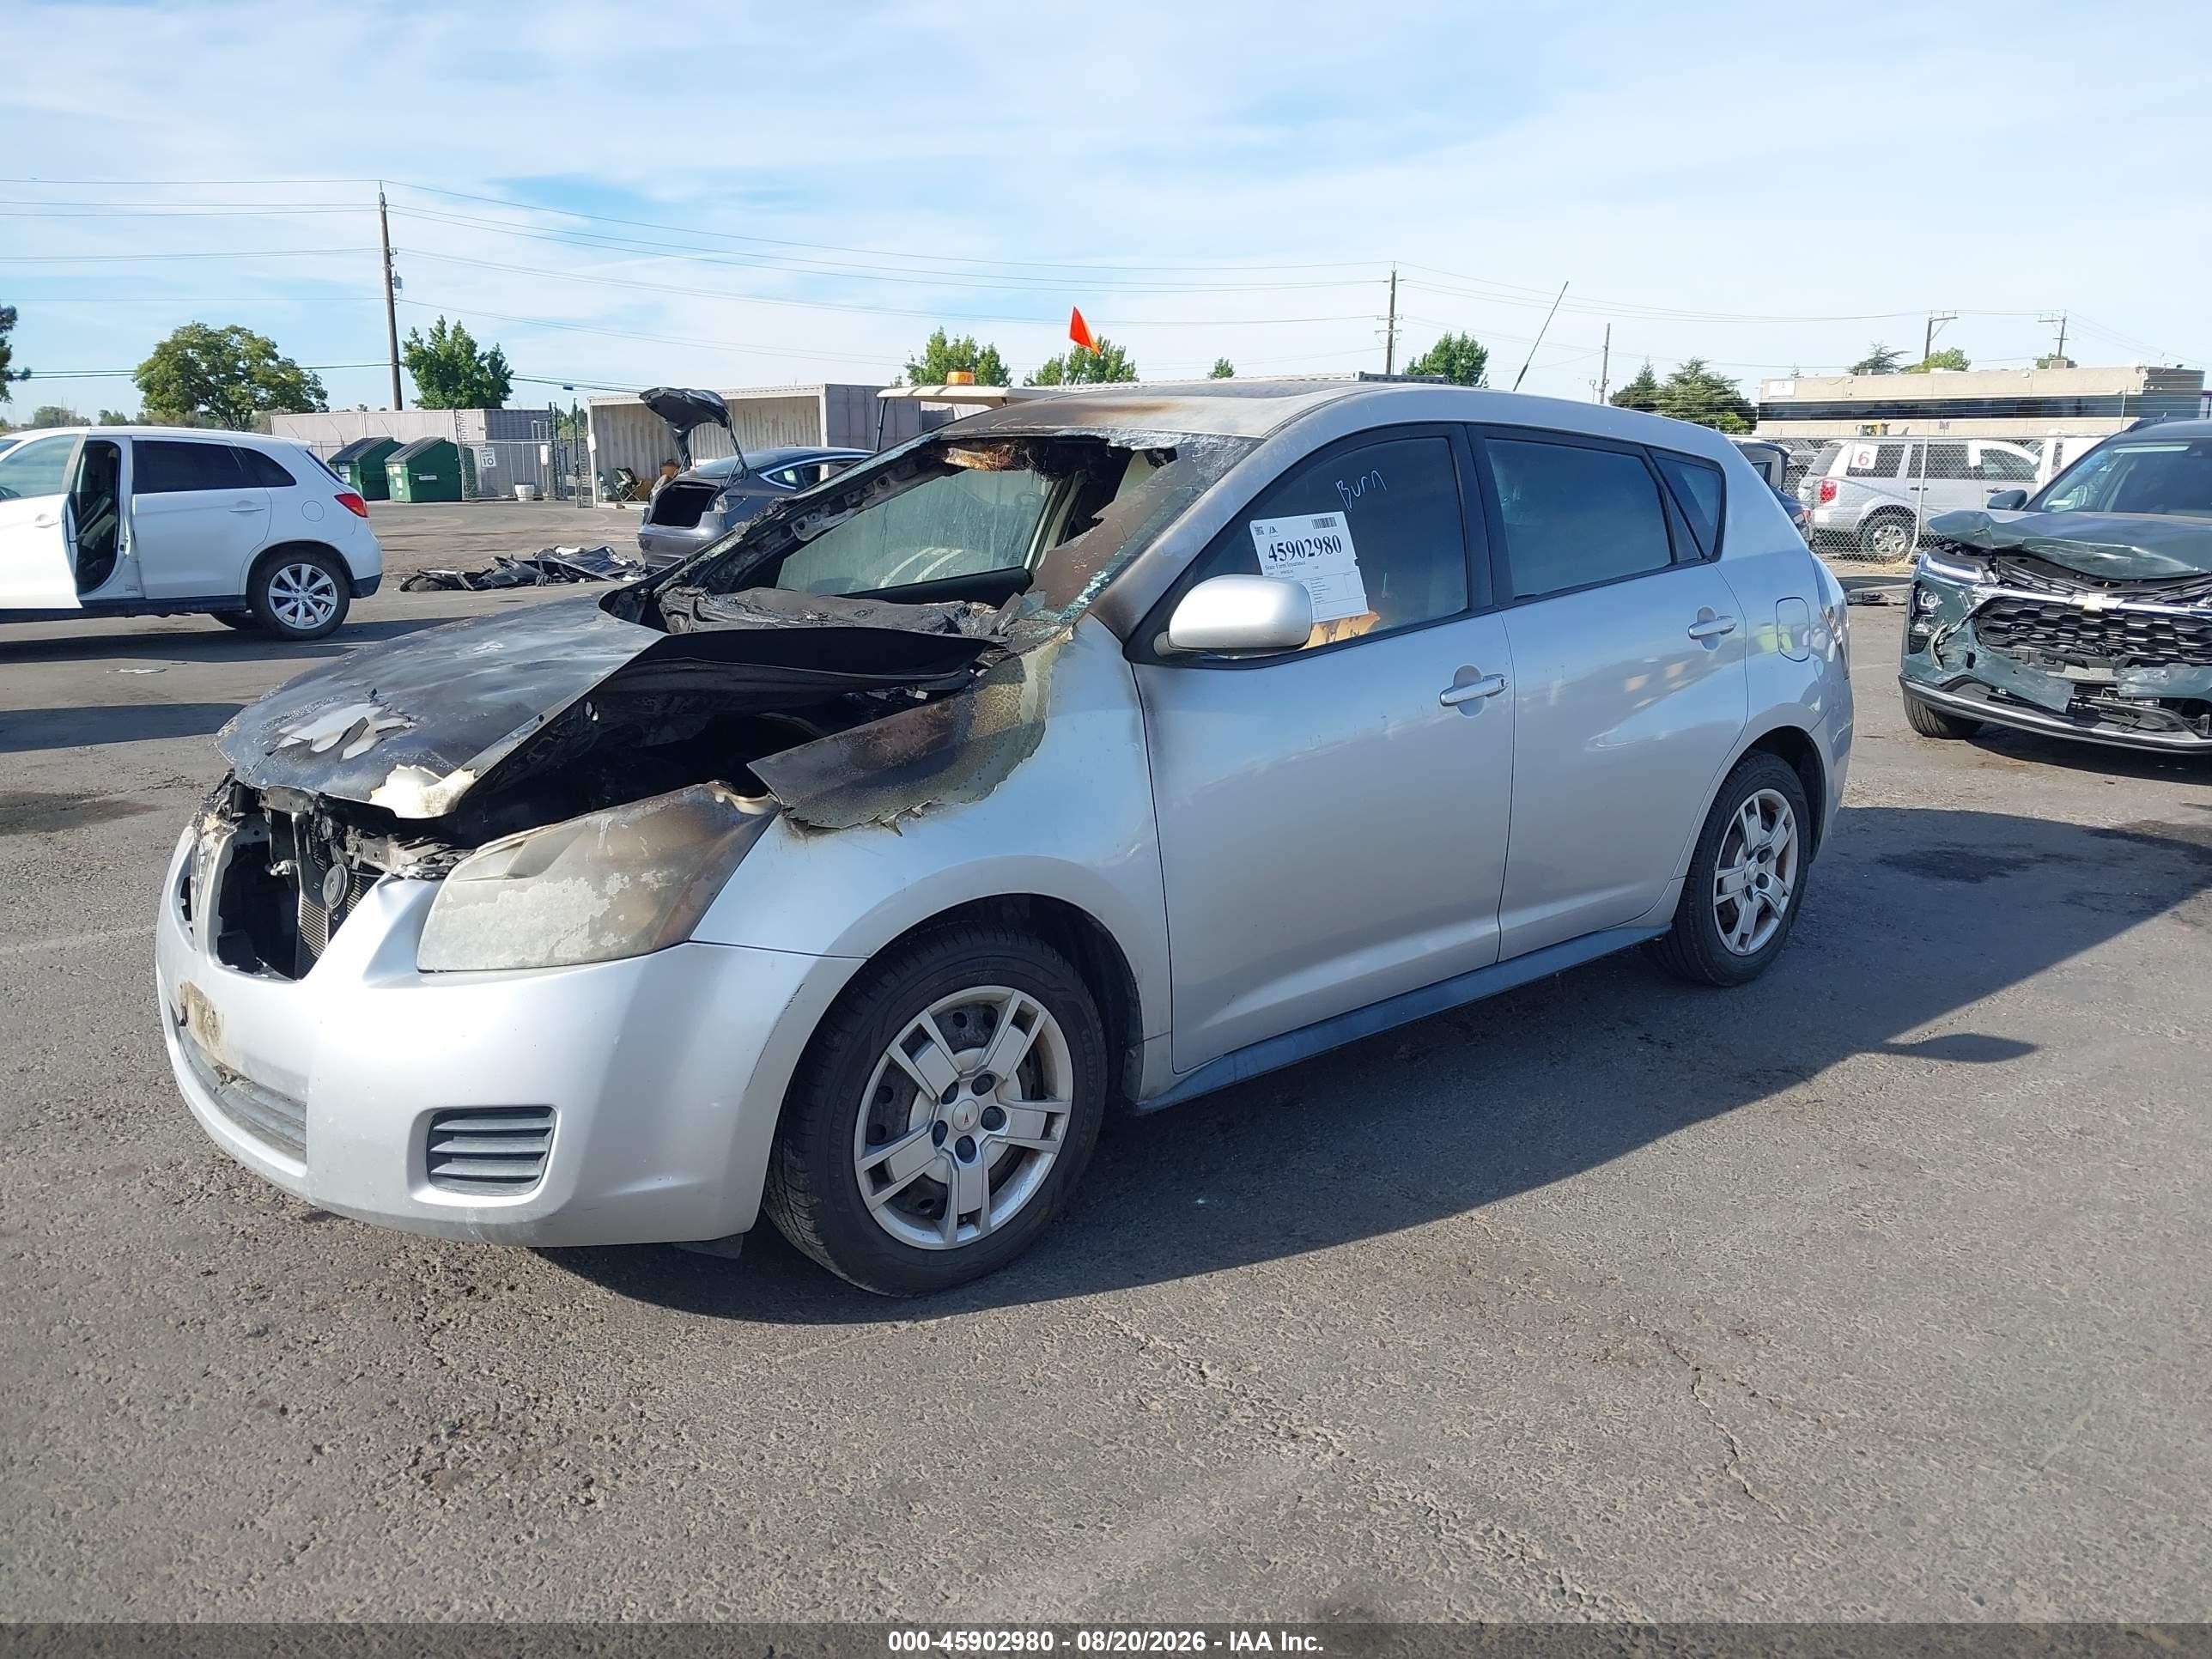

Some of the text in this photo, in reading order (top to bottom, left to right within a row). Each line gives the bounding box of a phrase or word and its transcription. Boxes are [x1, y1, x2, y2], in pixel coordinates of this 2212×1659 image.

[1858, 452, 1871, 466] 6
[1335, 470, 1387, 513] Burn
[1268, 535, 1342, 562] 45902980
